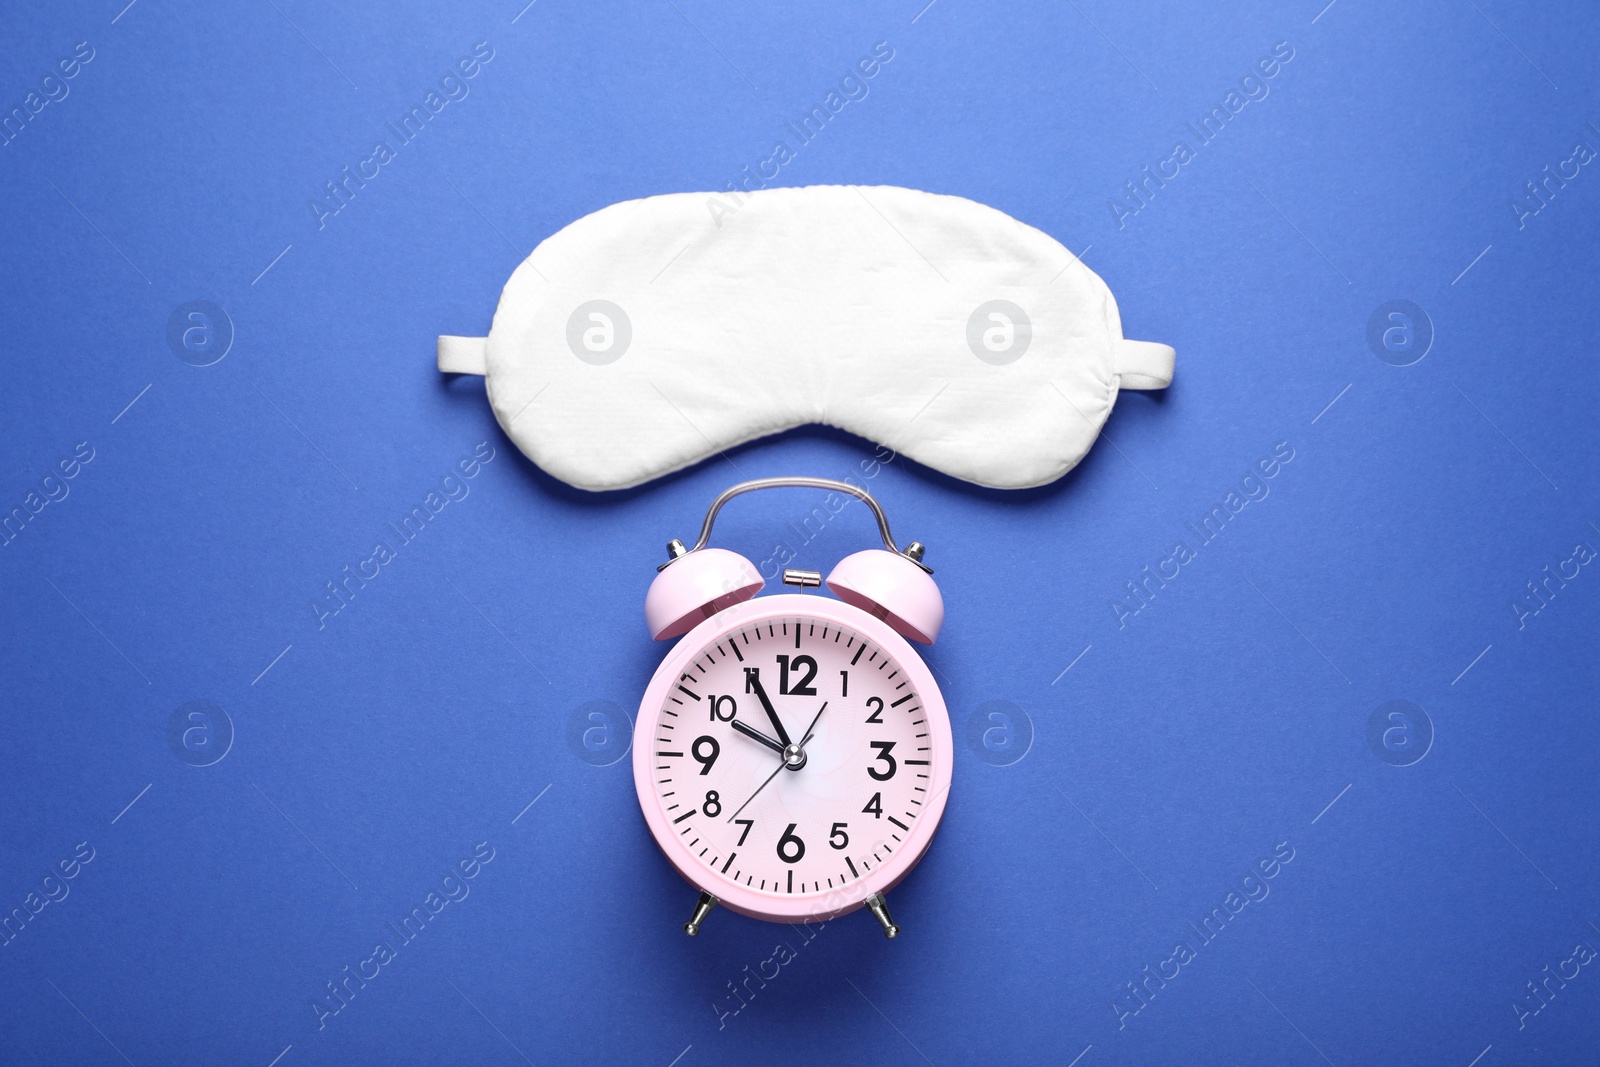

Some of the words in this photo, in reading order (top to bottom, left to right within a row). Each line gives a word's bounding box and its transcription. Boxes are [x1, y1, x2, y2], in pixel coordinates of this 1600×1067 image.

[776, 655, 818, 696] 12
[840, 671, 848, 697] 1
[708, 695, 737, 722] 10
[865, 696, 885, 724] 2
[691, 735, 720, 776] 9
[867, 741, 897, 781] 3
[702, 790, 722, 818] 8
[861, 792, 883, 819] 4
[735, 820, 755, 847] 7
[776, 823, 806, 864] 6
[828, 823, 849, 850] 5
